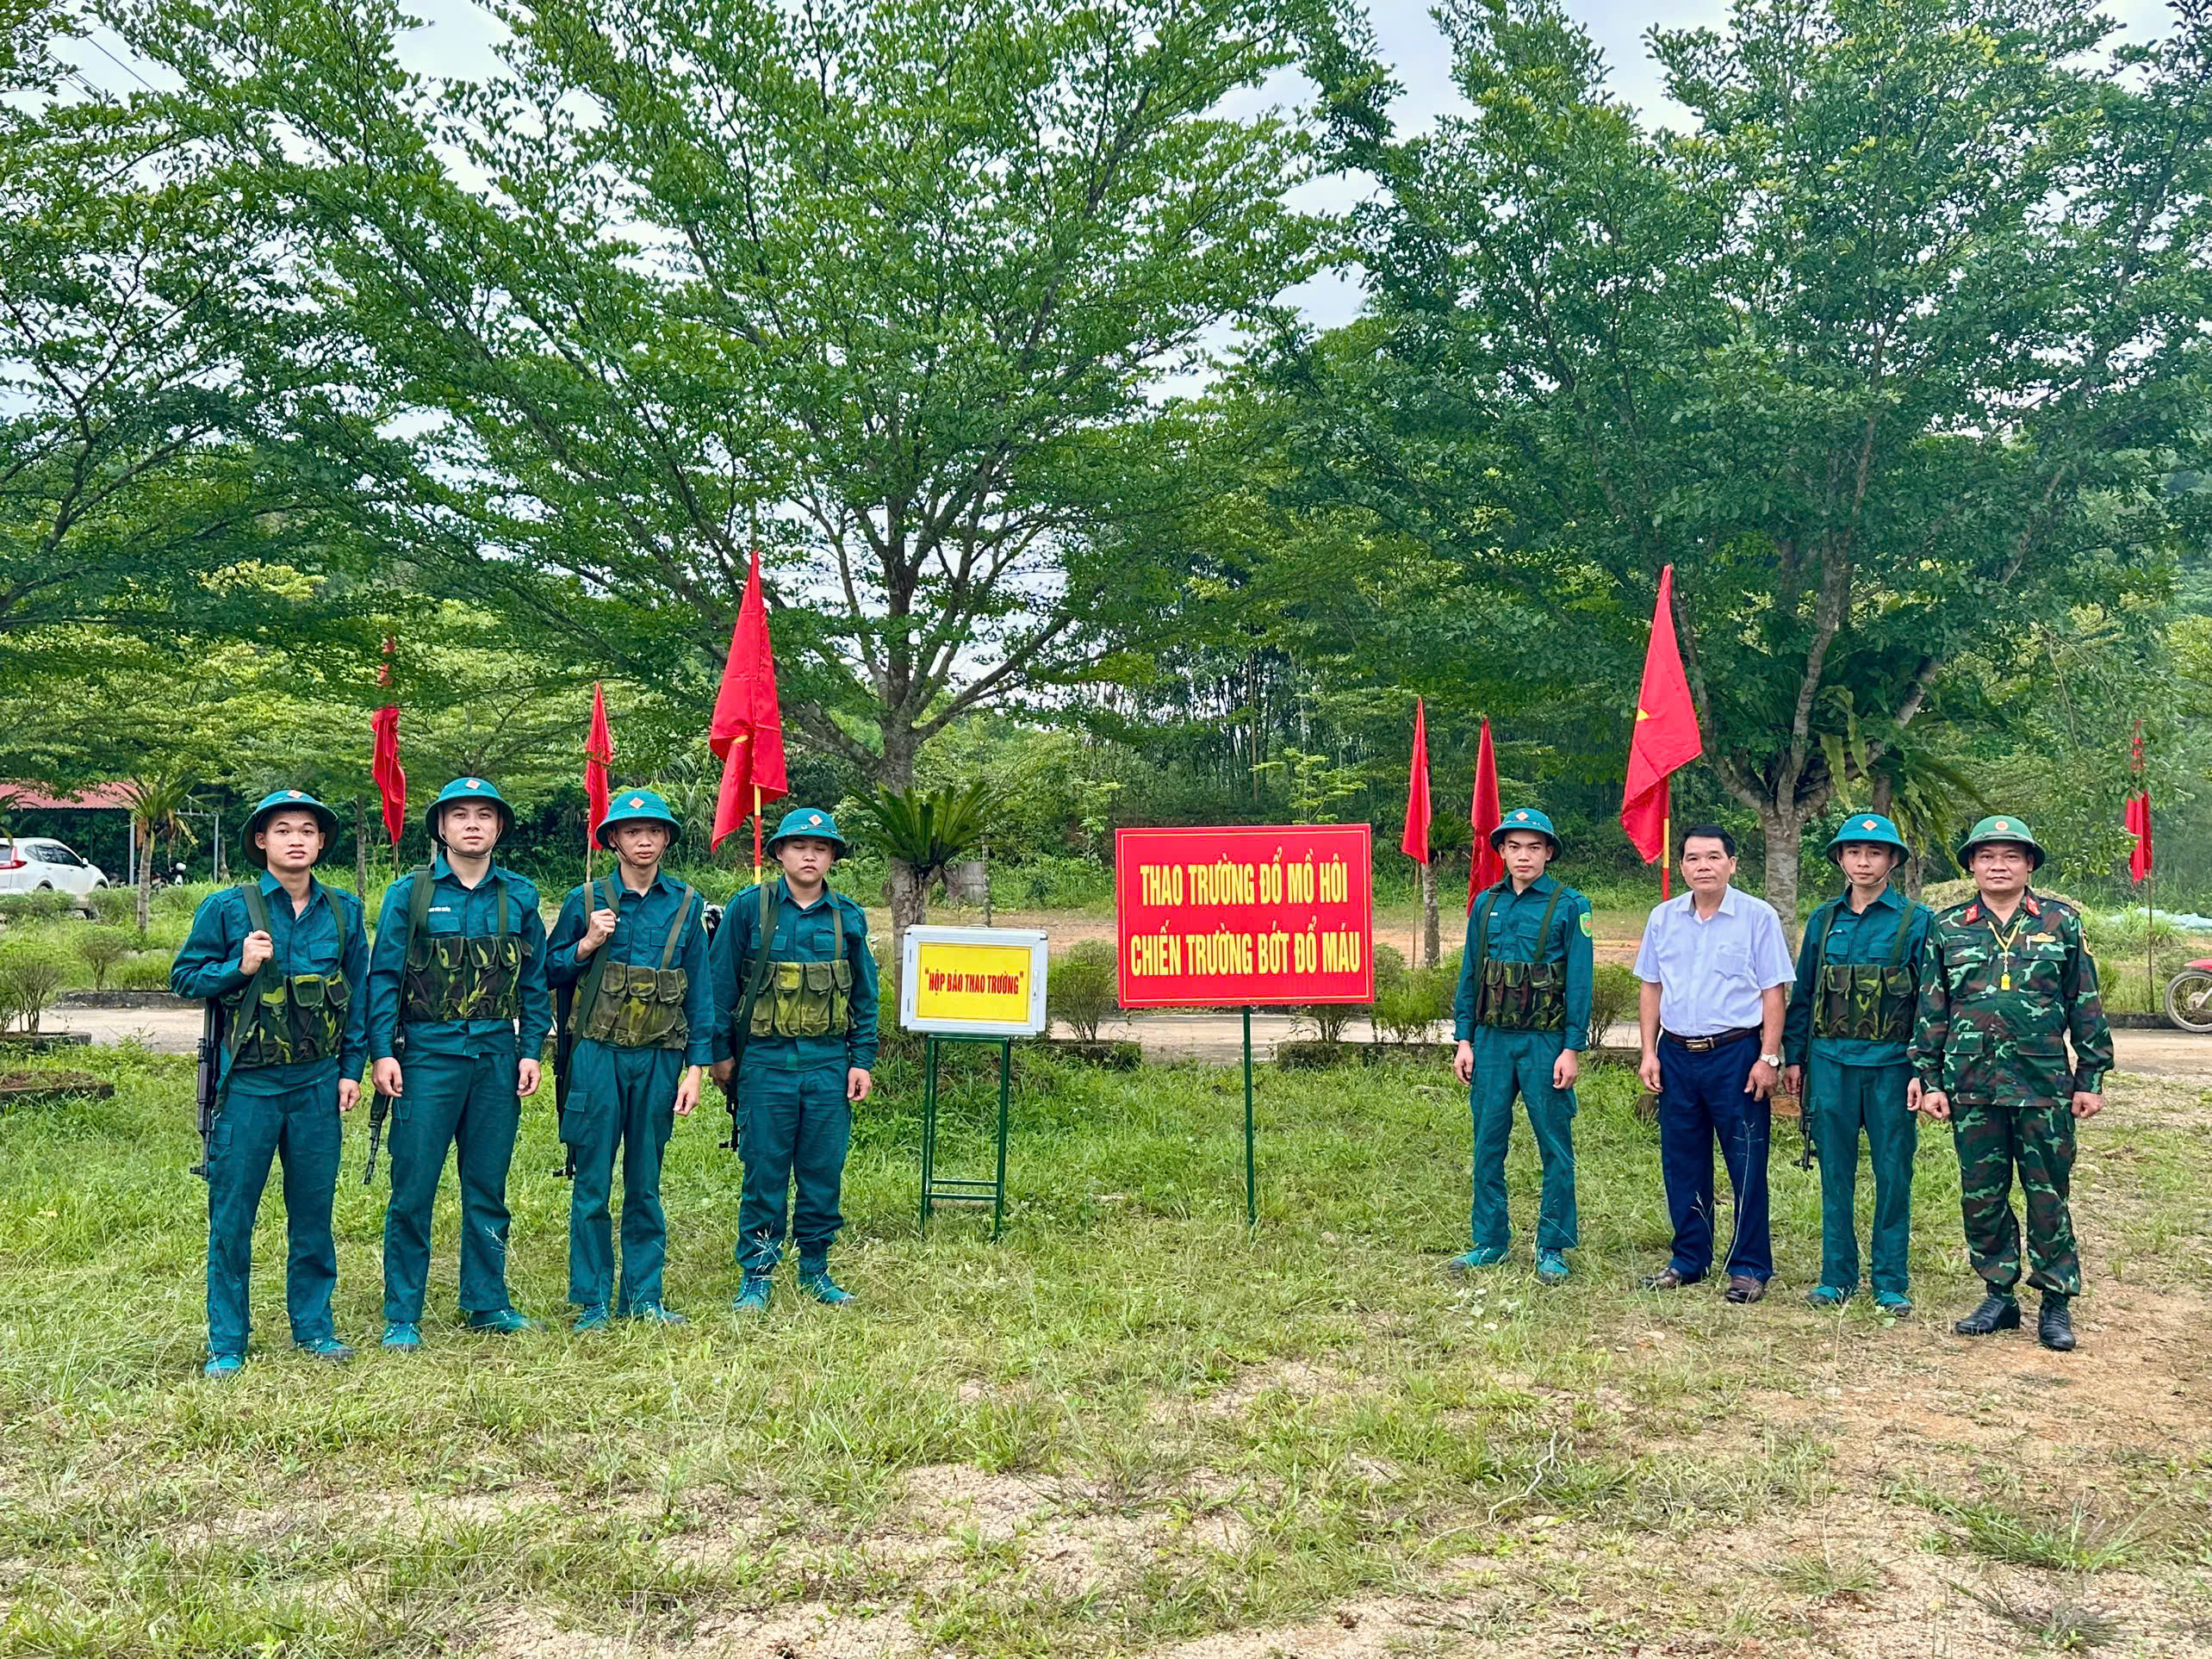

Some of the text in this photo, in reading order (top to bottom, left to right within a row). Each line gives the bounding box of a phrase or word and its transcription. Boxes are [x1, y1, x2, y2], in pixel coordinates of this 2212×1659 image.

[1140, 846, 1348, 906] THAO TRƯỜNG ĐỔ MỒ HÔI
[1130, 915, 1360, 976] CHIẾN TRƯỜNG BỚT ĐỔ MÁU
[947, 969, 963, 992] BÁO
[965, 973, 985, 993] THAO
